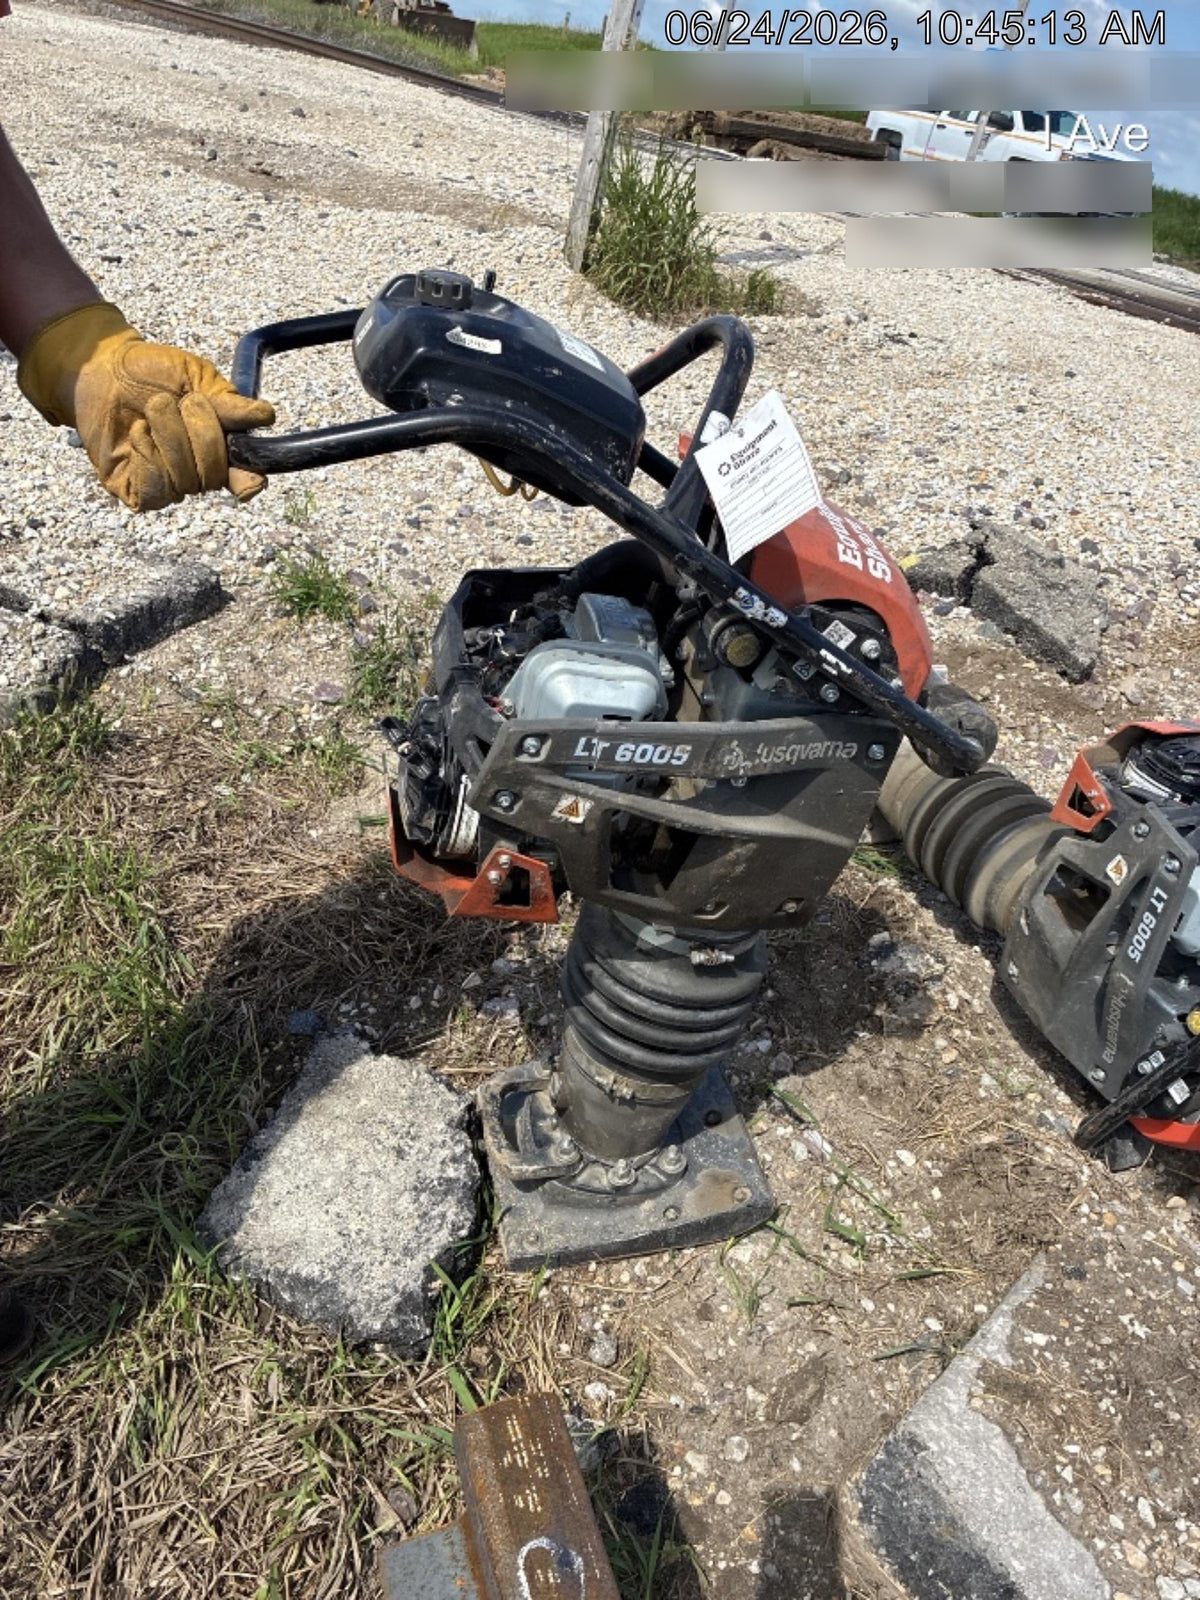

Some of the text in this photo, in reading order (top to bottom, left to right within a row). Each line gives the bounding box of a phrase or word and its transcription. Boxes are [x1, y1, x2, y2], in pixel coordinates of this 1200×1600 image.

[574, 736, 692, 765] LT 6005
[1127, 886, 1169, 964] LT 6005
